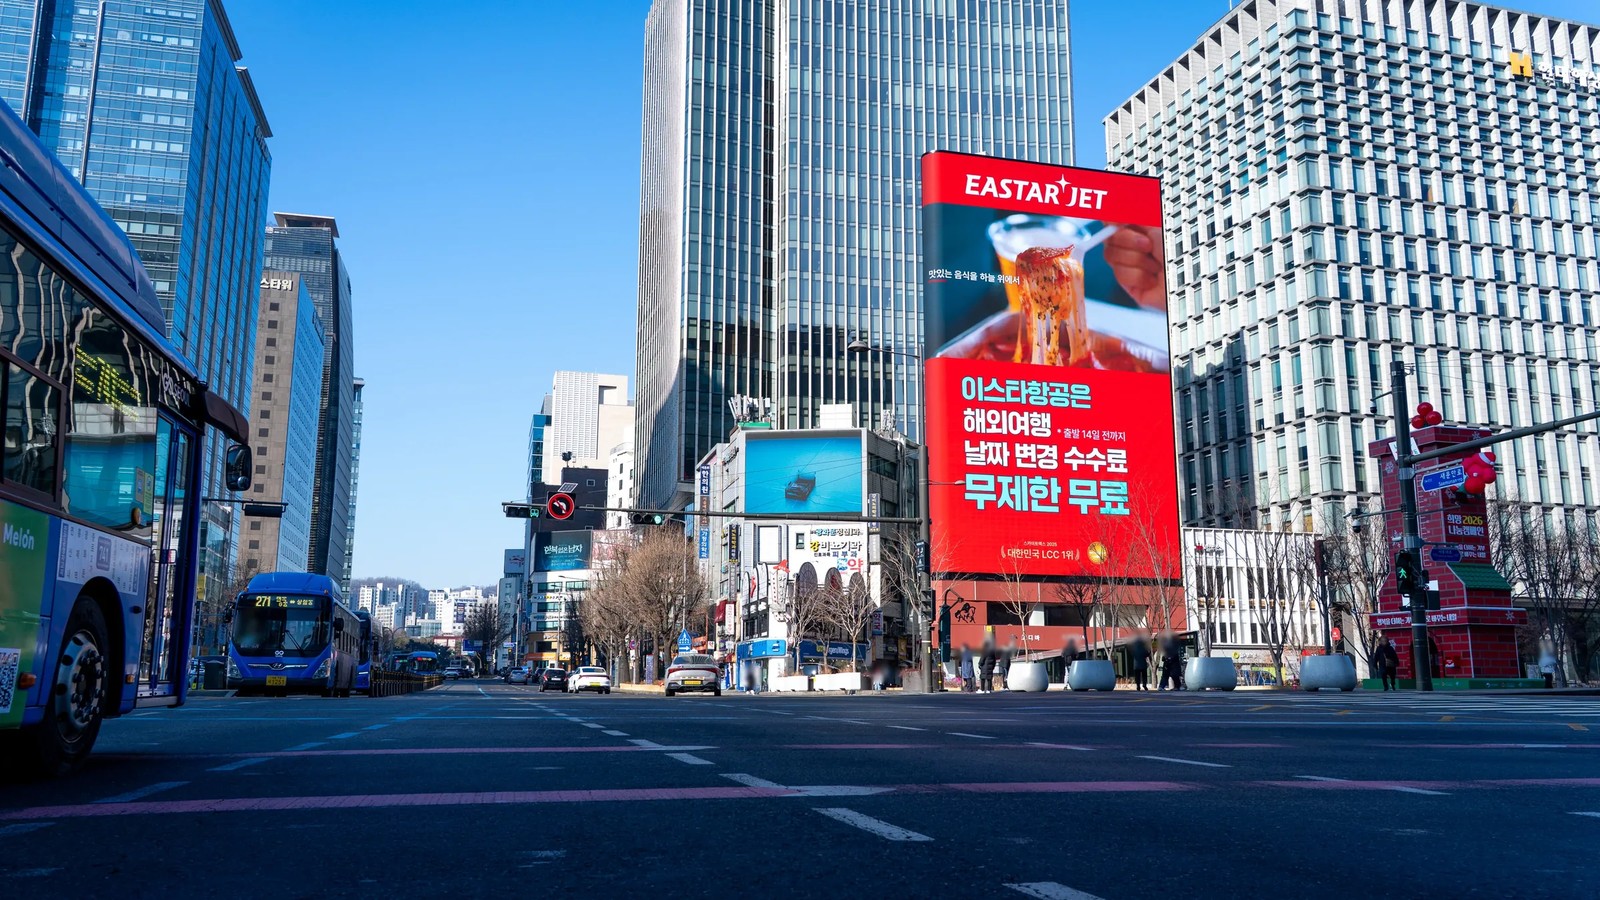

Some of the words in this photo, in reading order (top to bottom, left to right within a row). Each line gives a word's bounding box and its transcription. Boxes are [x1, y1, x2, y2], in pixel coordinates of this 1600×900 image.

[964, 174, 1060, 205] EASTAR
[1066, 187, 1108, 210] JET
[928, 268, 952, 280] 맛있는
[954, 270, 977, 282] 음식을
[980, 271, 995, 283] 하늘
[997, 273, 1020, 285] 위에서
[961, 376, 1092, 409] 이스타항공은
[963, 407, 1051, 438] 해외여행
[1063, 428, 1080, 440] 출발
[1082, 429, 1100, 440] 14일
[1101, 430, 1126, 442] 전까지
[964, 440, 1010, 467] 날짜
[1015, 442, 1058, 470] 변경
[1063, 446, 1129, 473] 수수료
[964, 473, 1062, 513] 무제한
[1068, 478, 1130, 516] 무료
[1447, 513, 1462, 525] 희망
[1462, 515, 1483, 525] 2026
[3, 523, 35, 550] Melon
[1448, 525, 1484, 536] 나눔캠페인
[1007, 548, 1040, 559] 대한민국
[1042, 549, 1060, 559] LCC
[1062, 550, 1074, 560] 1위
[255, 595, 271, 607] 271
